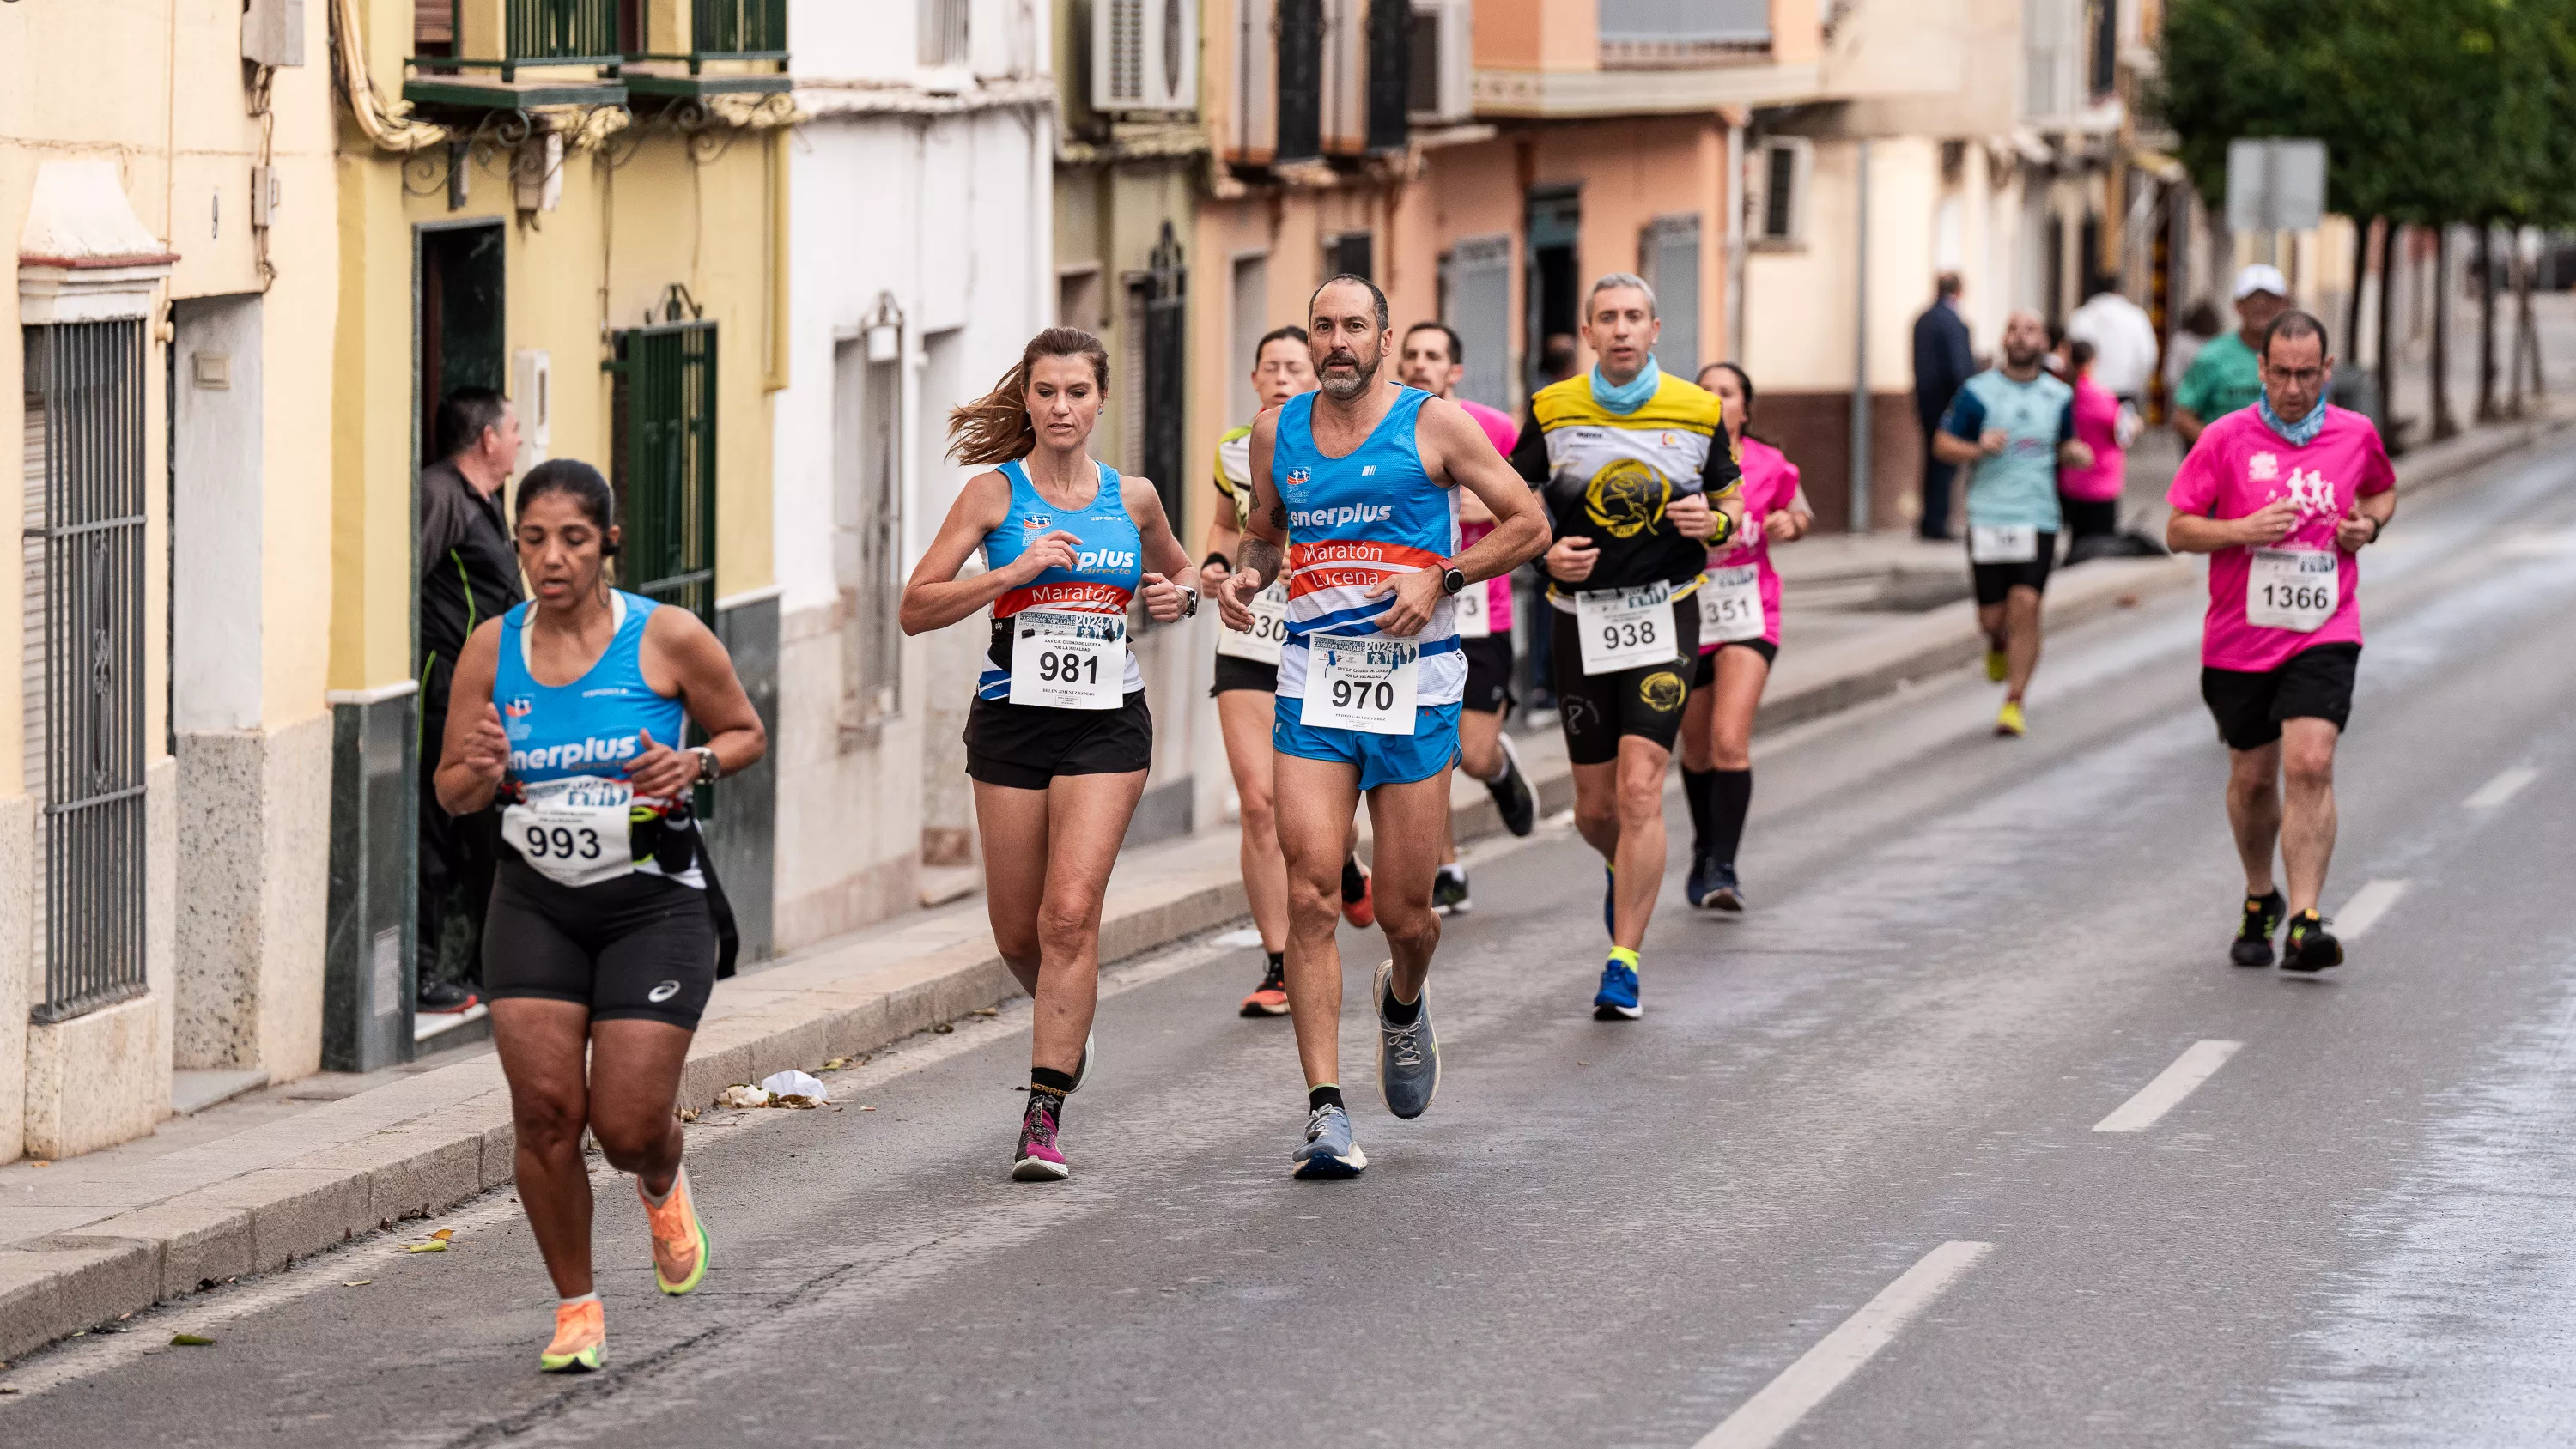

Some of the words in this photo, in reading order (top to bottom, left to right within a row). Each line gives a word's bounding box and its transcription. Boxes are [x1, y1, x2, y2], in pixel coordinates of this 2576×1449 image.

[1291, 502, 1392, 528] enerplus
[1303, 542, 1382, 564] Maratón
[1082, 567, 1132, 575] directo
[1310, 570, 1379, 588] Lucena
[1032, 585, 1117, 603] Maratón
[2262, 584, 2328, 610] 1366
[1076, 615, 1103, 627] 2024
[1603, 621, 1656, 650] 938
[1339, 644, 1366, 652] POPULARES
[1365, 642, 1394, 653] 2024
[1039, 652, 1098, 685] 981
[1332, 679, 1394, 711] 970
[526, 825, 601, 859] 993
